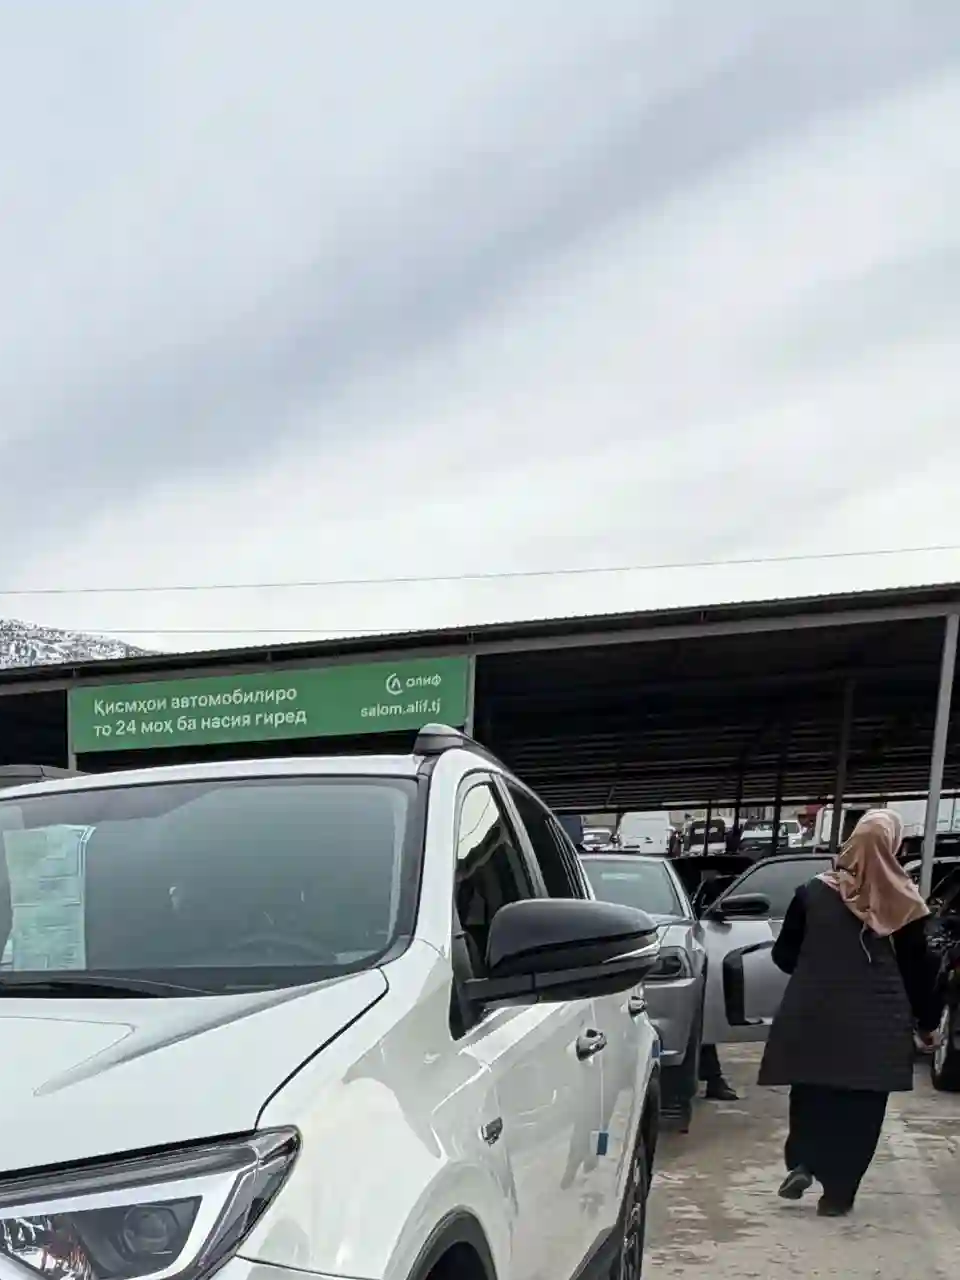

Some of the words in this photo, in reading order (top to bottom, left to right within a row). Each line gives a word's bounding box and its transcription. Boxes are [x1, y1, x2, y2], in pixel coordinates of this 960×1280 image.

[93, 698, 167, 717] Қисмҳои
[171, 687, 298, 709] автомобилиро
[360, 698, 441, 718] salom.alif.tj
[93, 725, 113, 738] то
[115, 719, 137, 736] 24
[141, 719, 174, 735] моҳ
[177, 715, 197, 732] ба
[201, 714, 251, 730] насия
[255, 708, 308, 728] гиред
